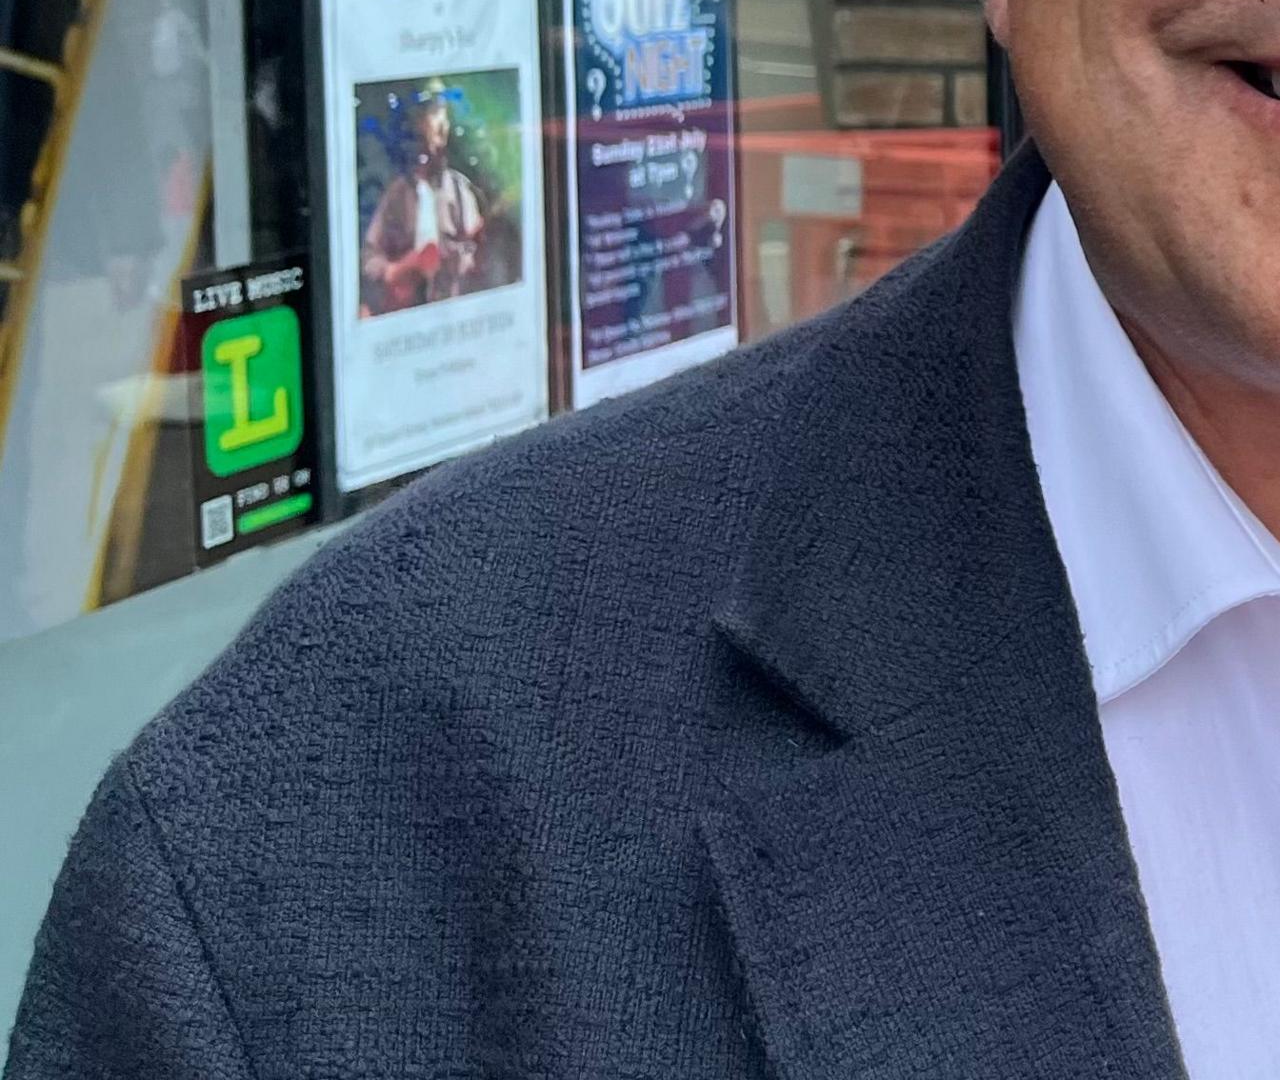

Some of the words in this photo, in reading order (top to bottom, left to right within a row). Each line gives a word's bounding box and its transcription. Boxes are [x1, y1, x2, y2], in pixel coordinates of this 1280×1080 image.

[622, 32, 707, 102] NIGHT
[592, 138, 646, 167] Sunday
[193, 281, 243, 314] LIVE
[246, 266, 304, 301] MUSIC
[214, 334, 289, 452] L
